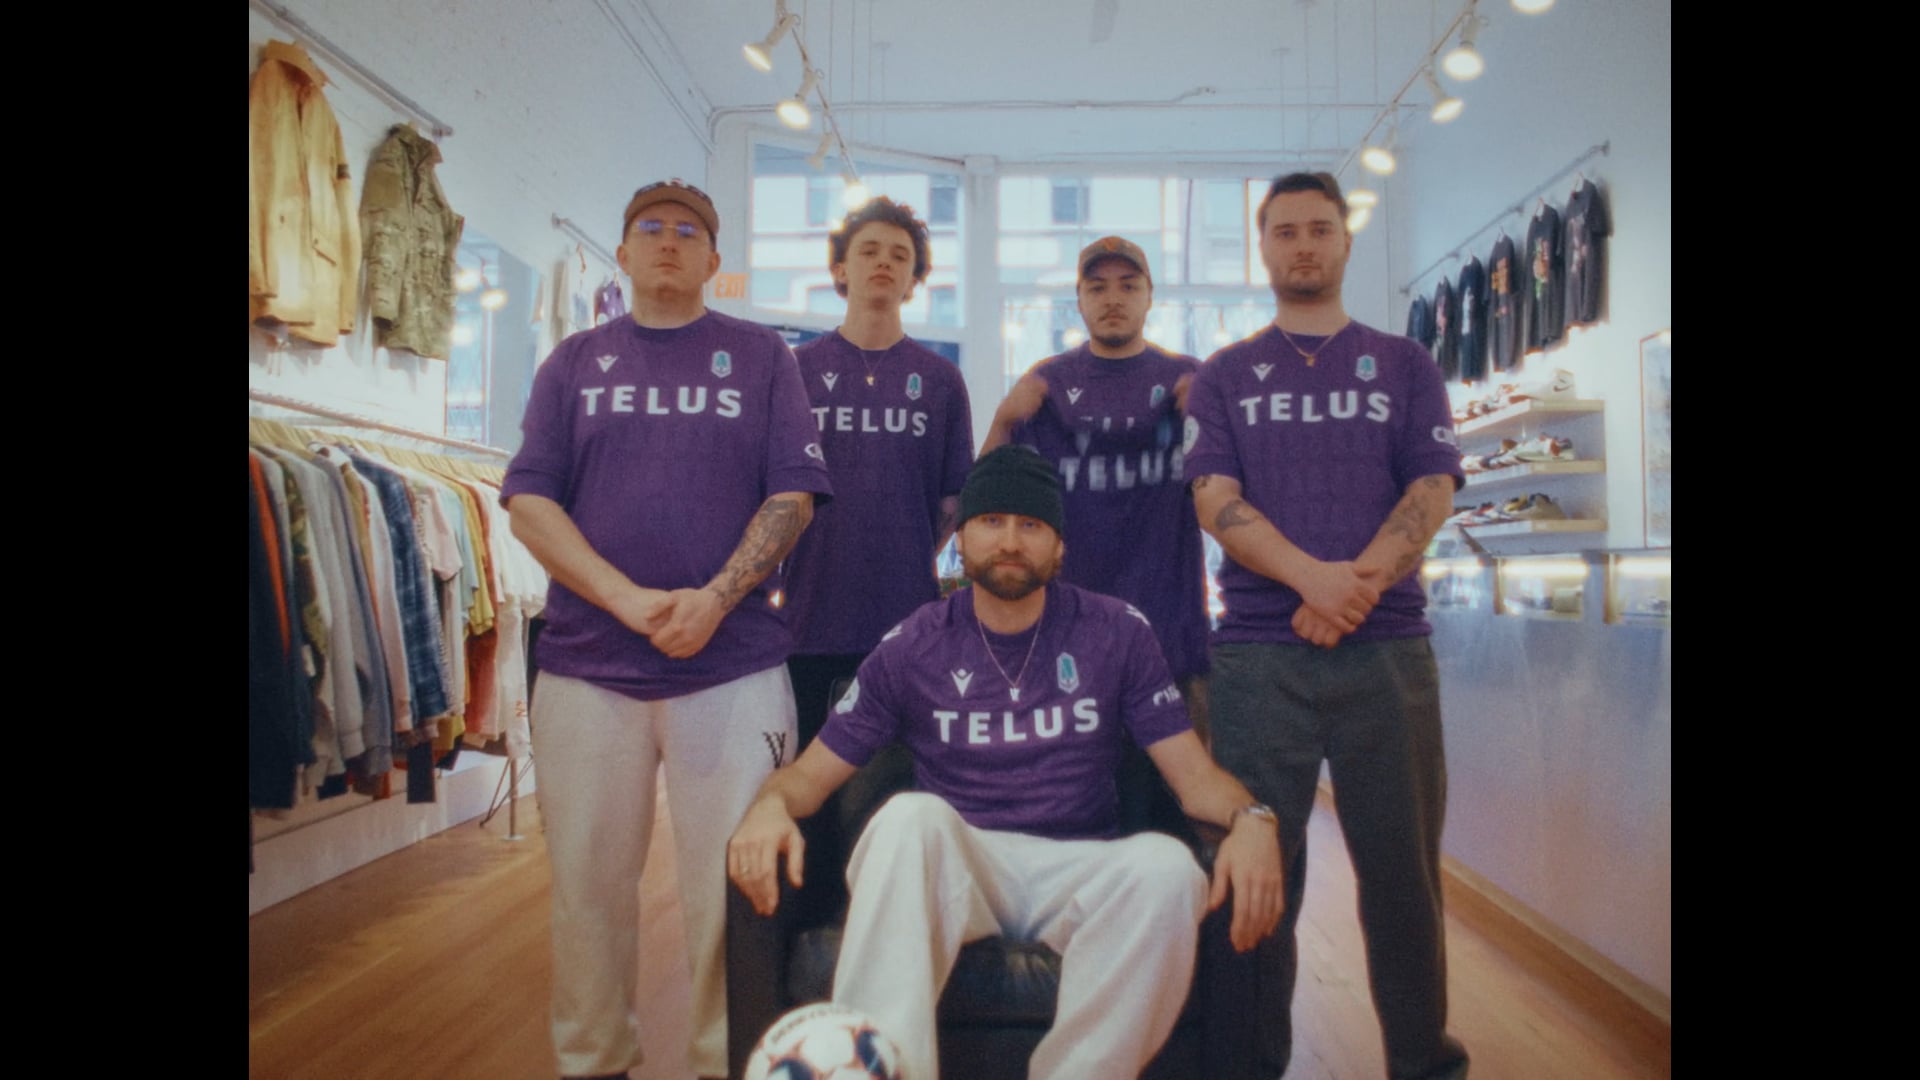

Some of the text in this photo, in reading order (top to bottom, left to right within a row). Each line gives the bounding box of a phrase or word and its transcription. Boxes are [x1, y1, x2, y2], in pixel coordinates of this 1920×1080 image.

[715, 272, 747, 298] EXIT
[580, 386, 742, 418] TELUS
[1239, 390, 1391, 426] TELUS
[811, 406, 928, 437] TELUS
[933, 698, 1099, 744] TELUS
